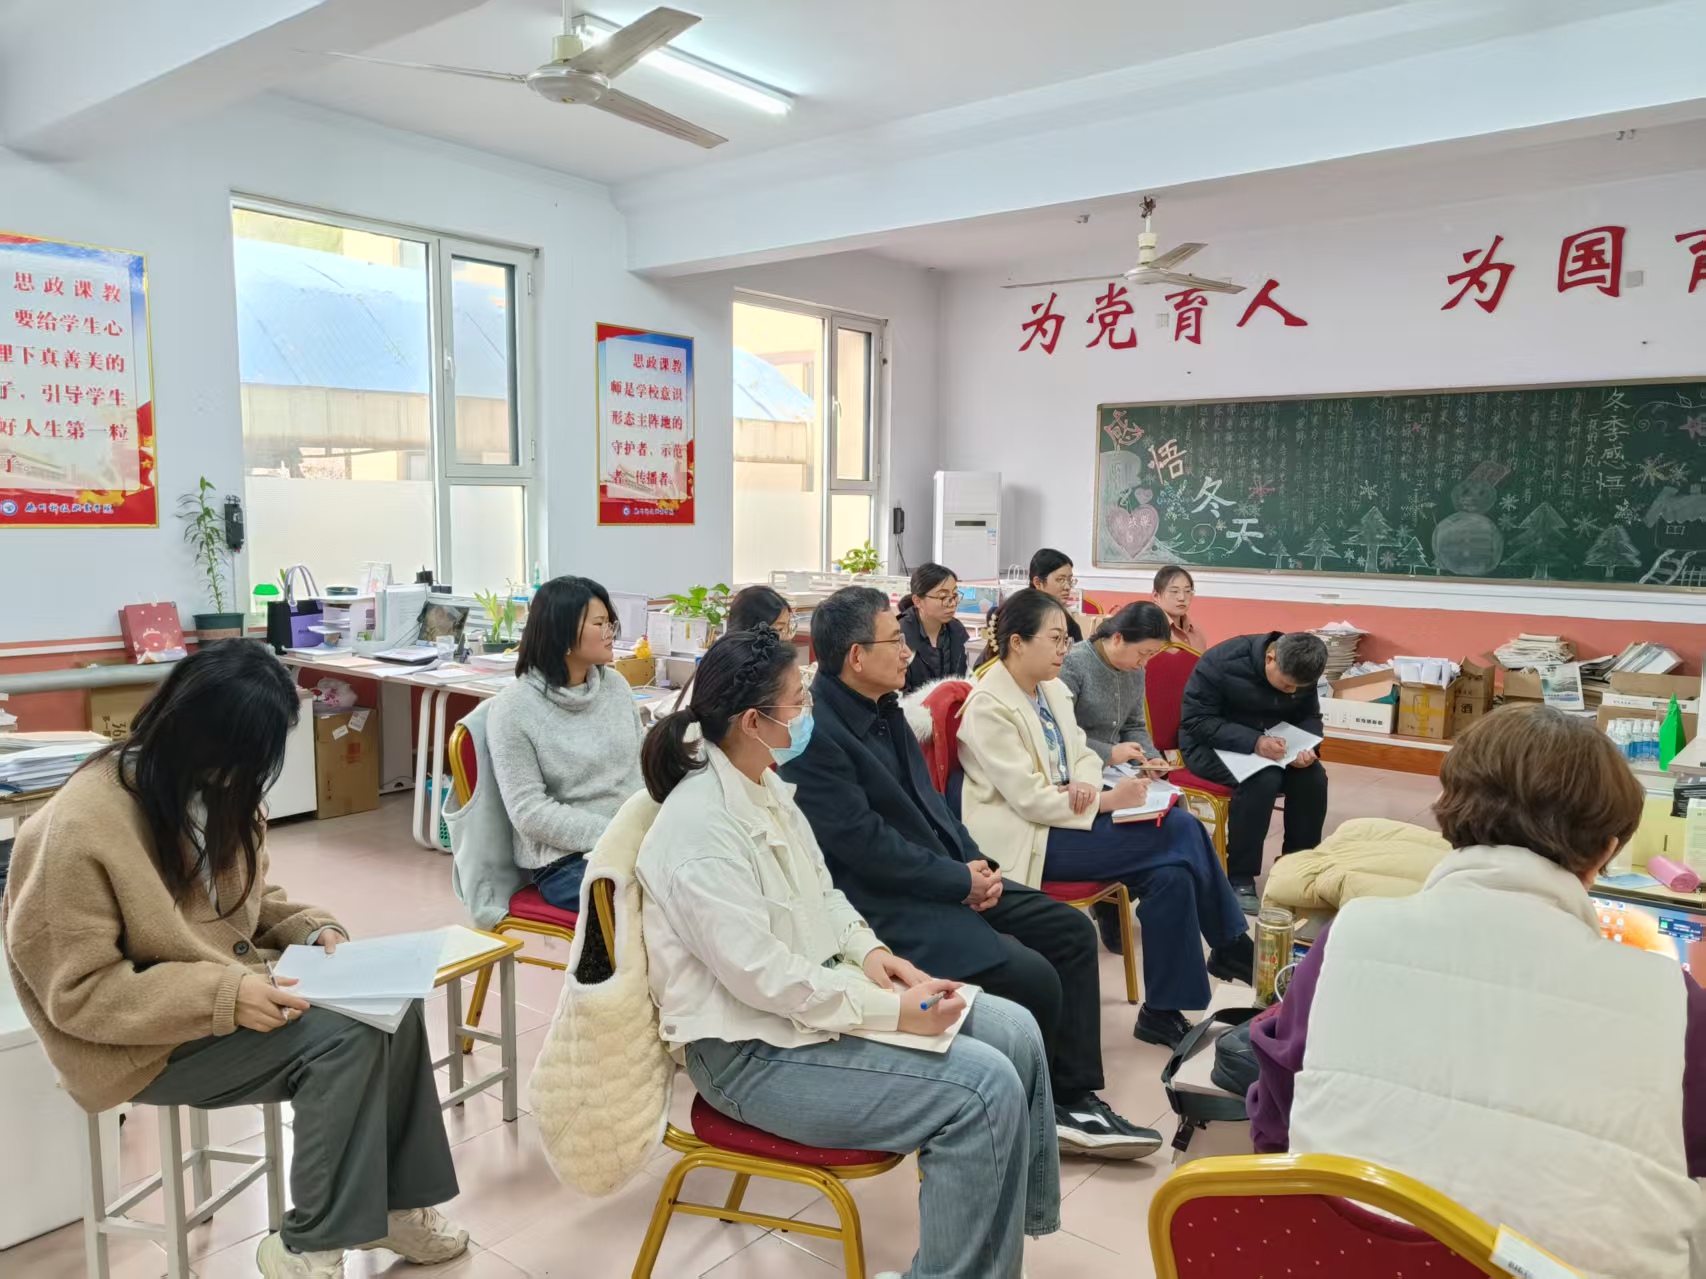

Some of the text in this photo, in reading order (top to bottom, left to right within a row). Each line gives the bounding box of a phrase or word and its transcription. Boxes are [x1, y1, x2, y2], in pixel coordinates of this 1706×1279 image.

[14, 271, 121, 303] 思政课教
[14, 309, 123, 337] 要给学生心
[1018, 278, 1308, 355] 为党育人
[633, 353, 682, 374] 思政课教
[610, 380, 684, 402] 师是学校意识
[610, 410, 684, 431] 形态主阵地的
[611, 439, 684, 459] 守护者、示范
[1596, 387, 1633, 500] 冬季感悟
